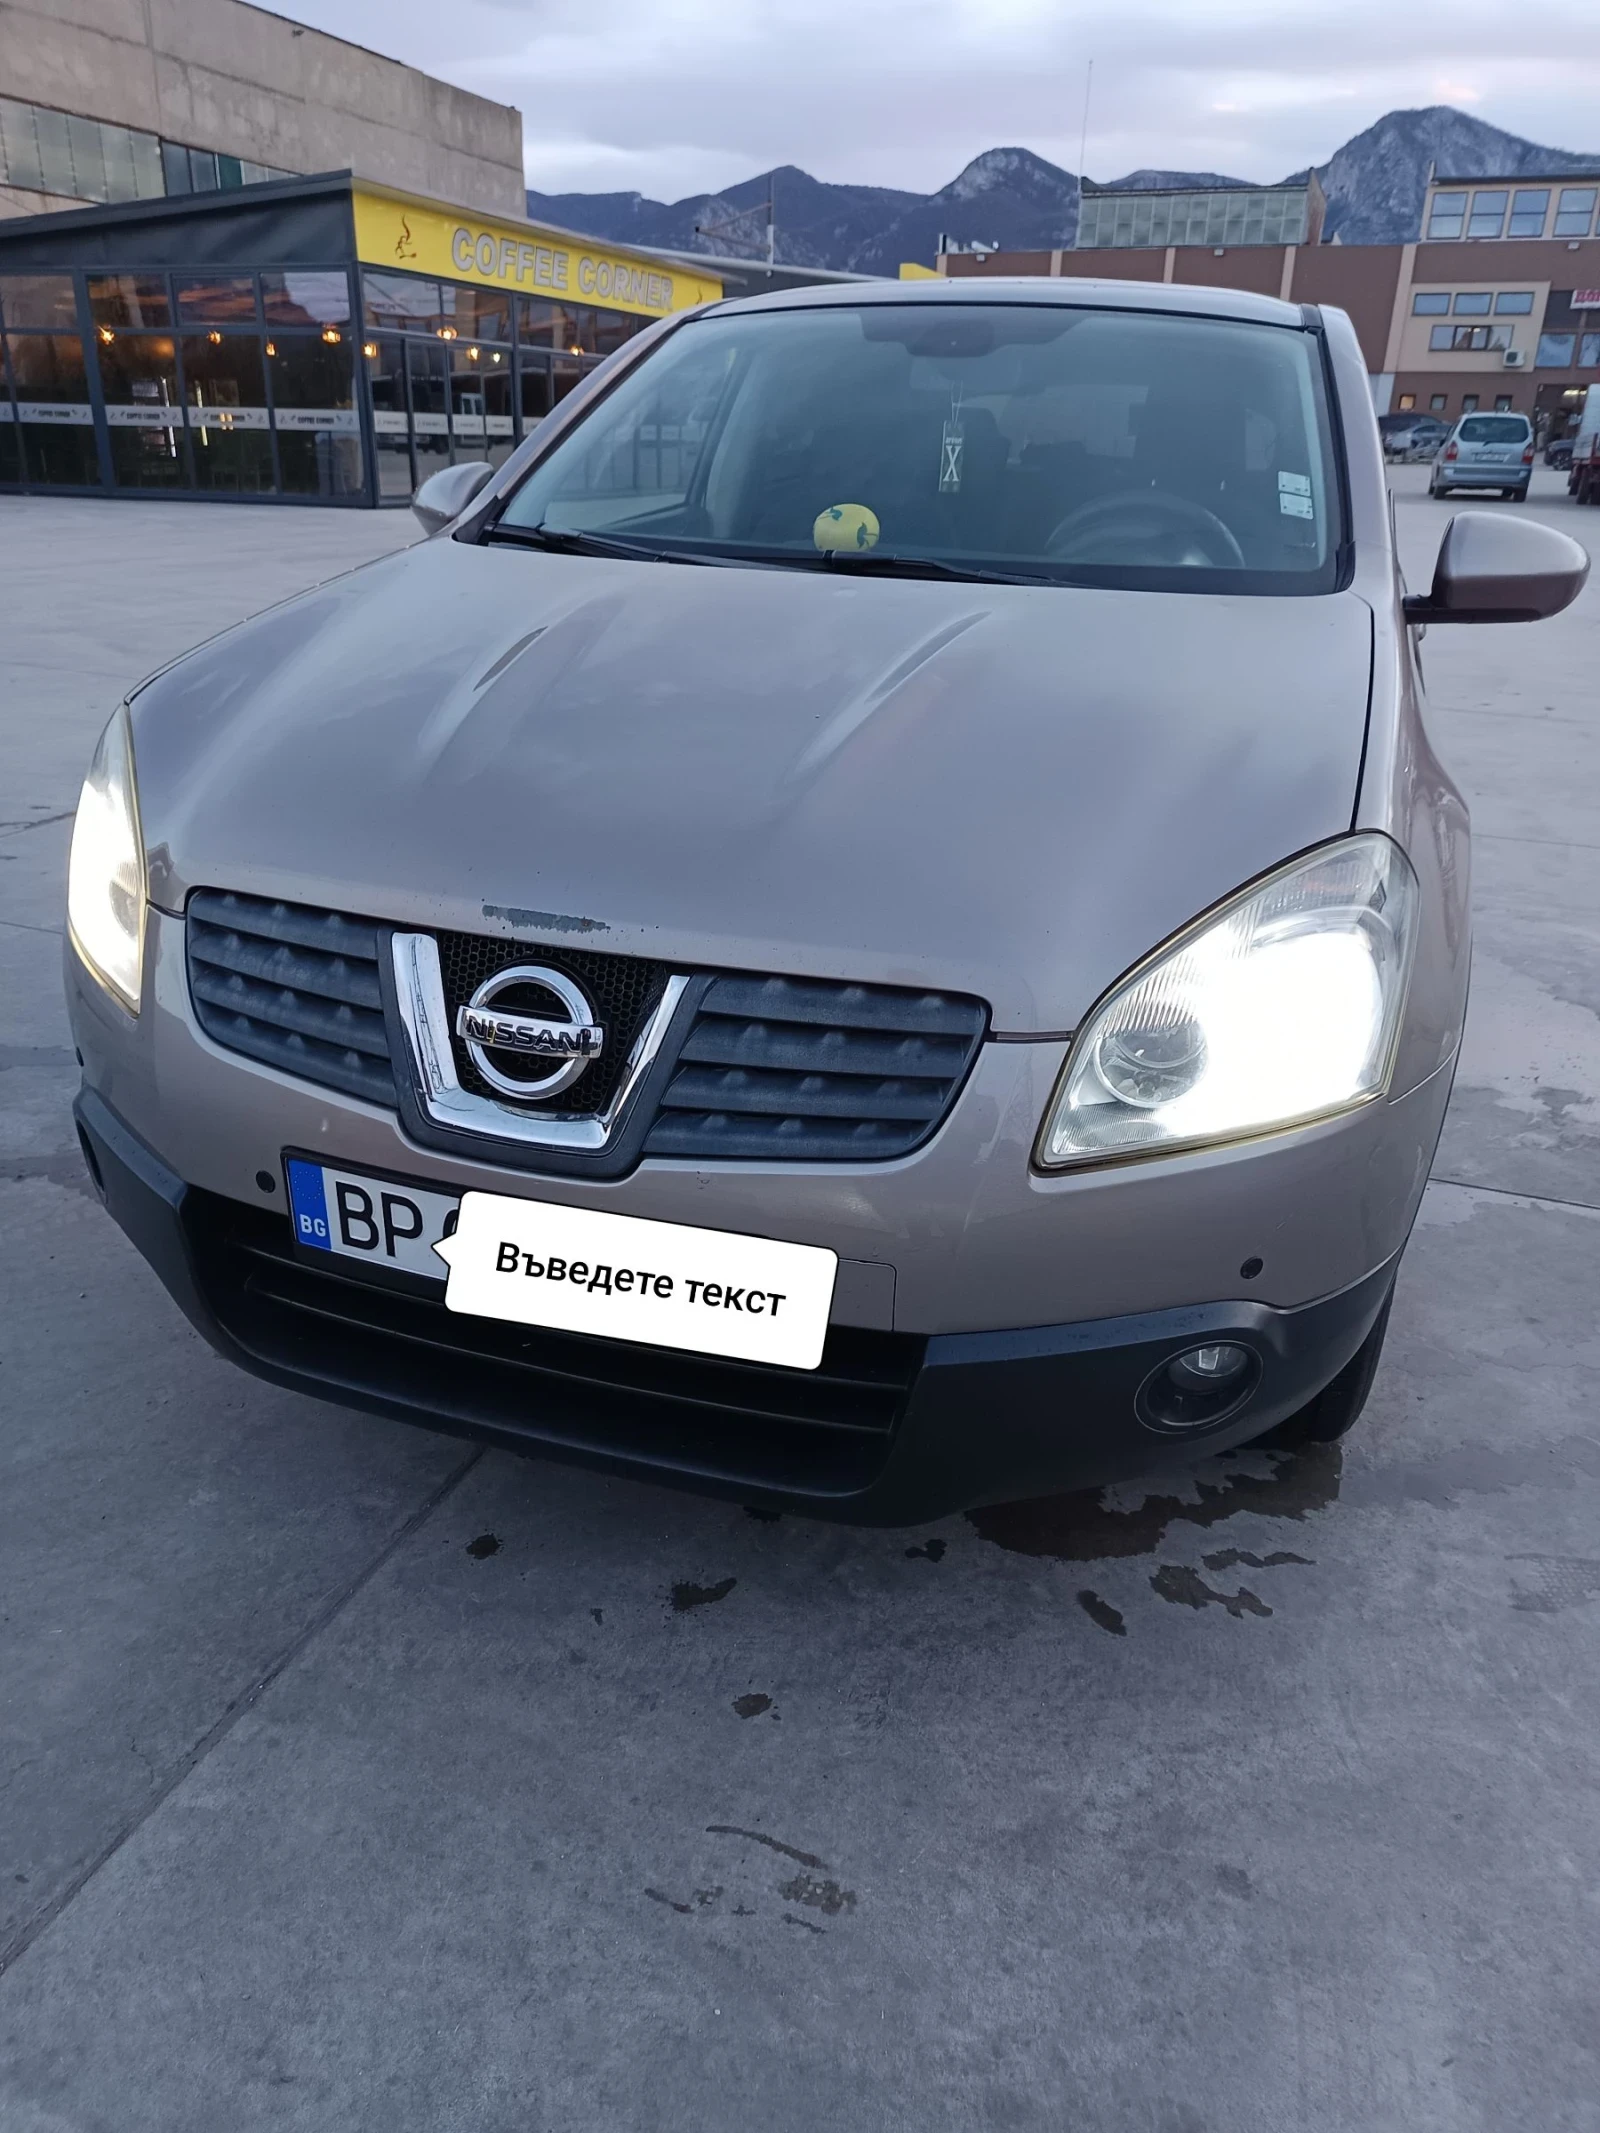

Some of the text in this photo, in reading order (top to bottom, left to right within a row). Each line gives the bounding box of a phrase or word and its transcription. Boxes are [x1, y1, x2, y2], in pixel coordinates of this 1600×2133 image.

[452, 227, 674, 311] COFFEE CORNER
[943, 445, 962, 482] X
[466, 1014, 584, 1054] NISSAN
[299, 1213, 327, 1237] BG
